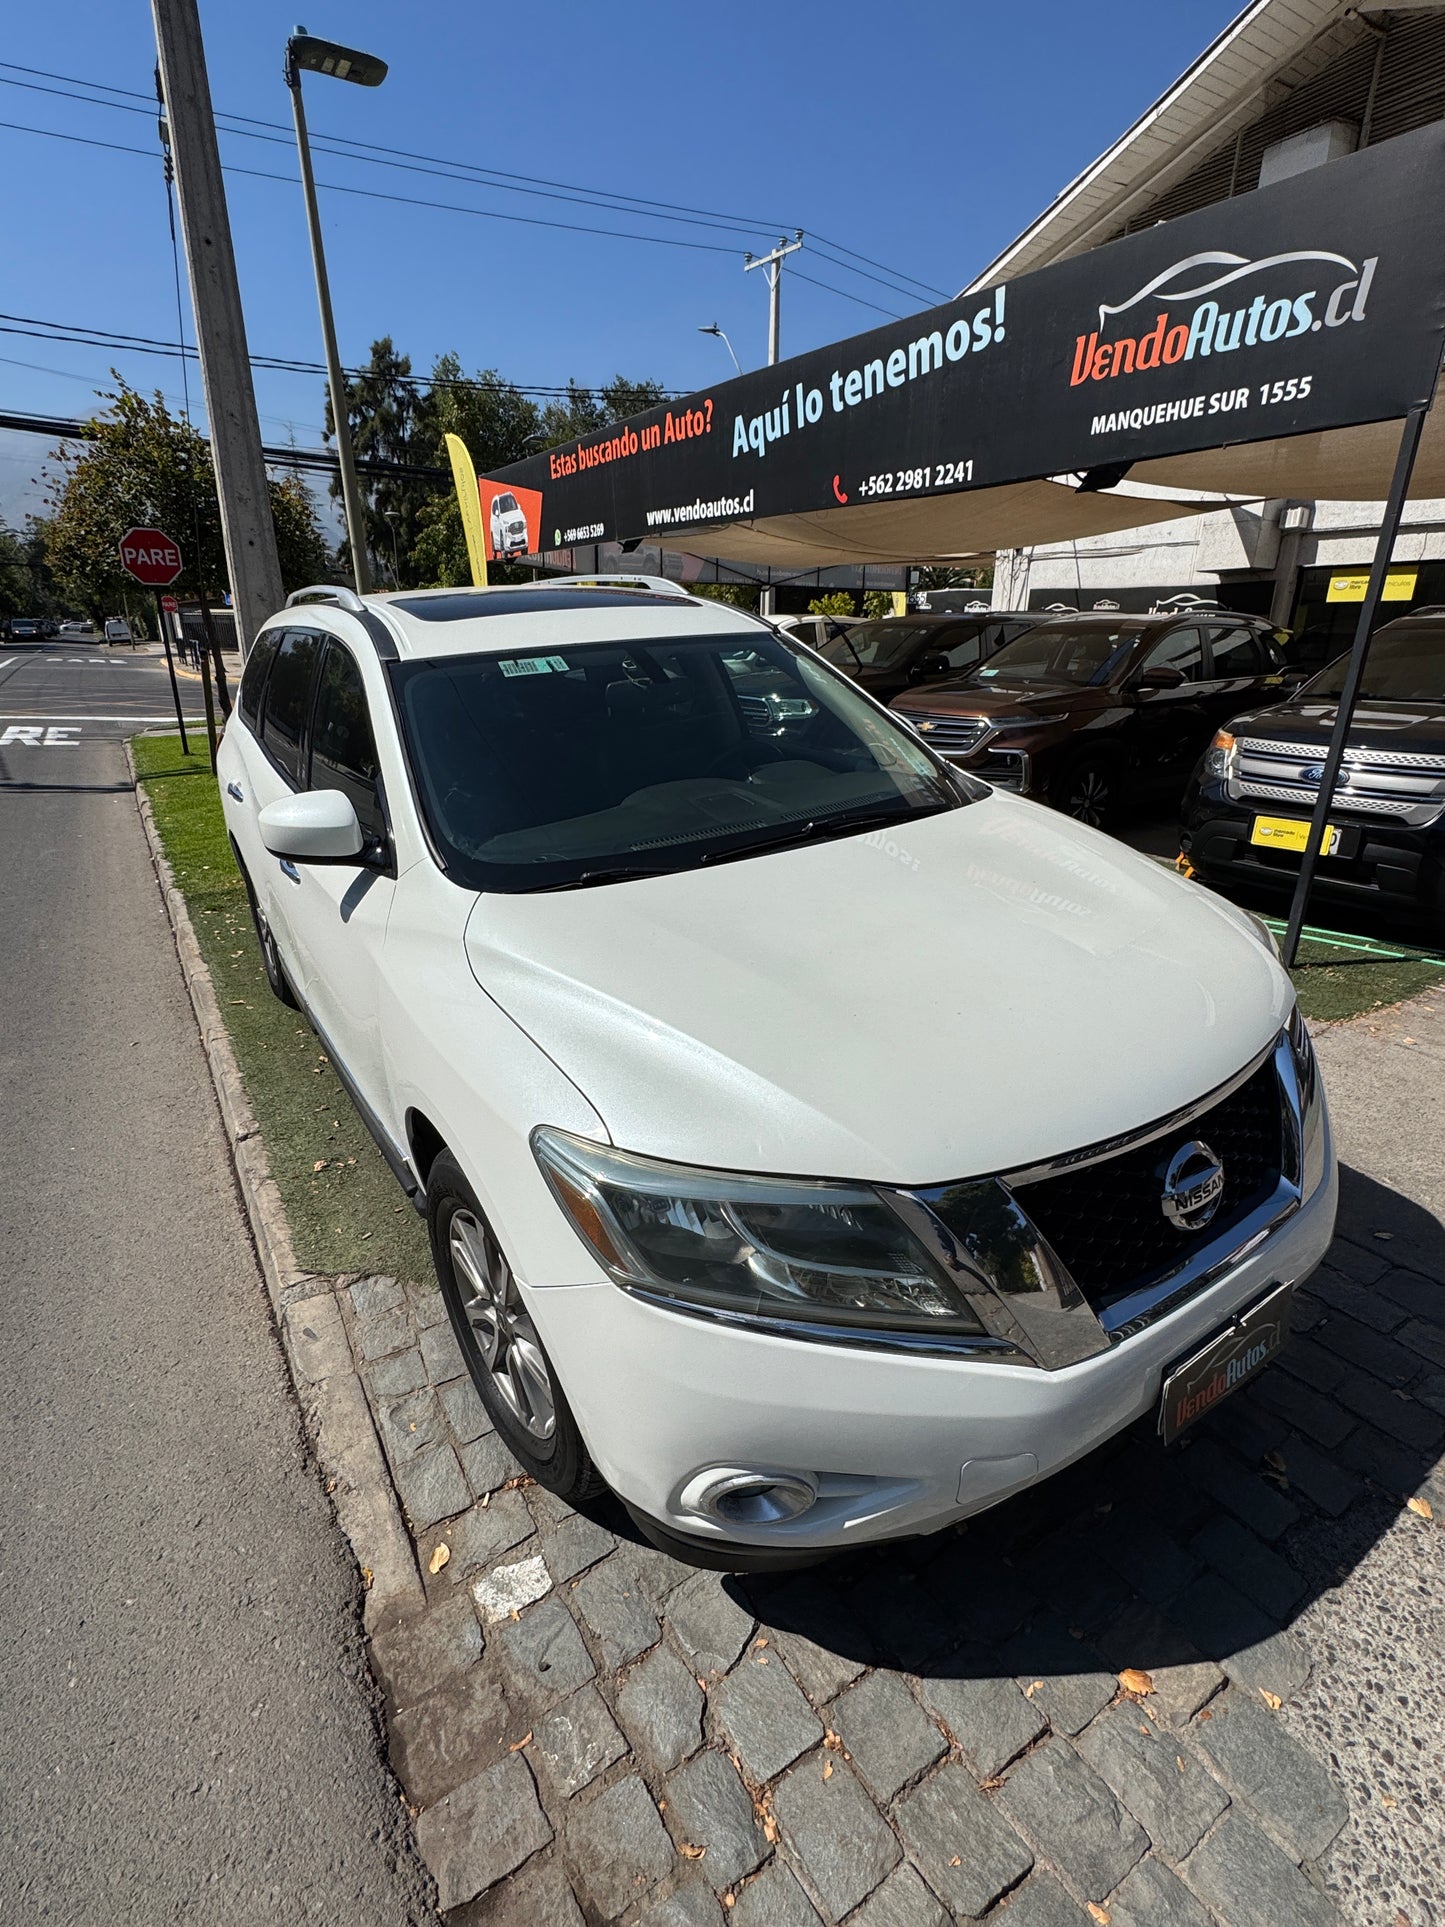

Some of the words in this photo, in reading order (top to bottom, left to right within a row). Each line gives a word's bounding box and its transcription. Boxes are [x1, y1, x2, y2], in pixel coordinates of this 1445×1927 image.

[1069, 256, 1379, 387] VendoAutos.cl
[732, 388, 790, 458] Aquí
[795, 382, 824, 430] lo
[829, 284, 1006, 413] tenemos!
[1090, 395, 1205, 435] MANQUEHUE
[1207, 387, 1250, 414] SUR
[1259, 376, 1313, 406] 1555
[549, 451, 578, 480] Estas
[577, 425, 639, 471] buscando
[641, 424, 661, 452] un
[664, 398, 714, 445] Auto?
[858, 472, 894, 497] +562
[895, 466, 931, 492] 2981
[934, 459, 974, 486] 2241
[646, 488, 754, 526] www.vendoautos.cl
[563, 527, 577, 542] +569
[123, 547, 178, 566] PARE
[1174, 1172, 1224, 1212] NISSAN
